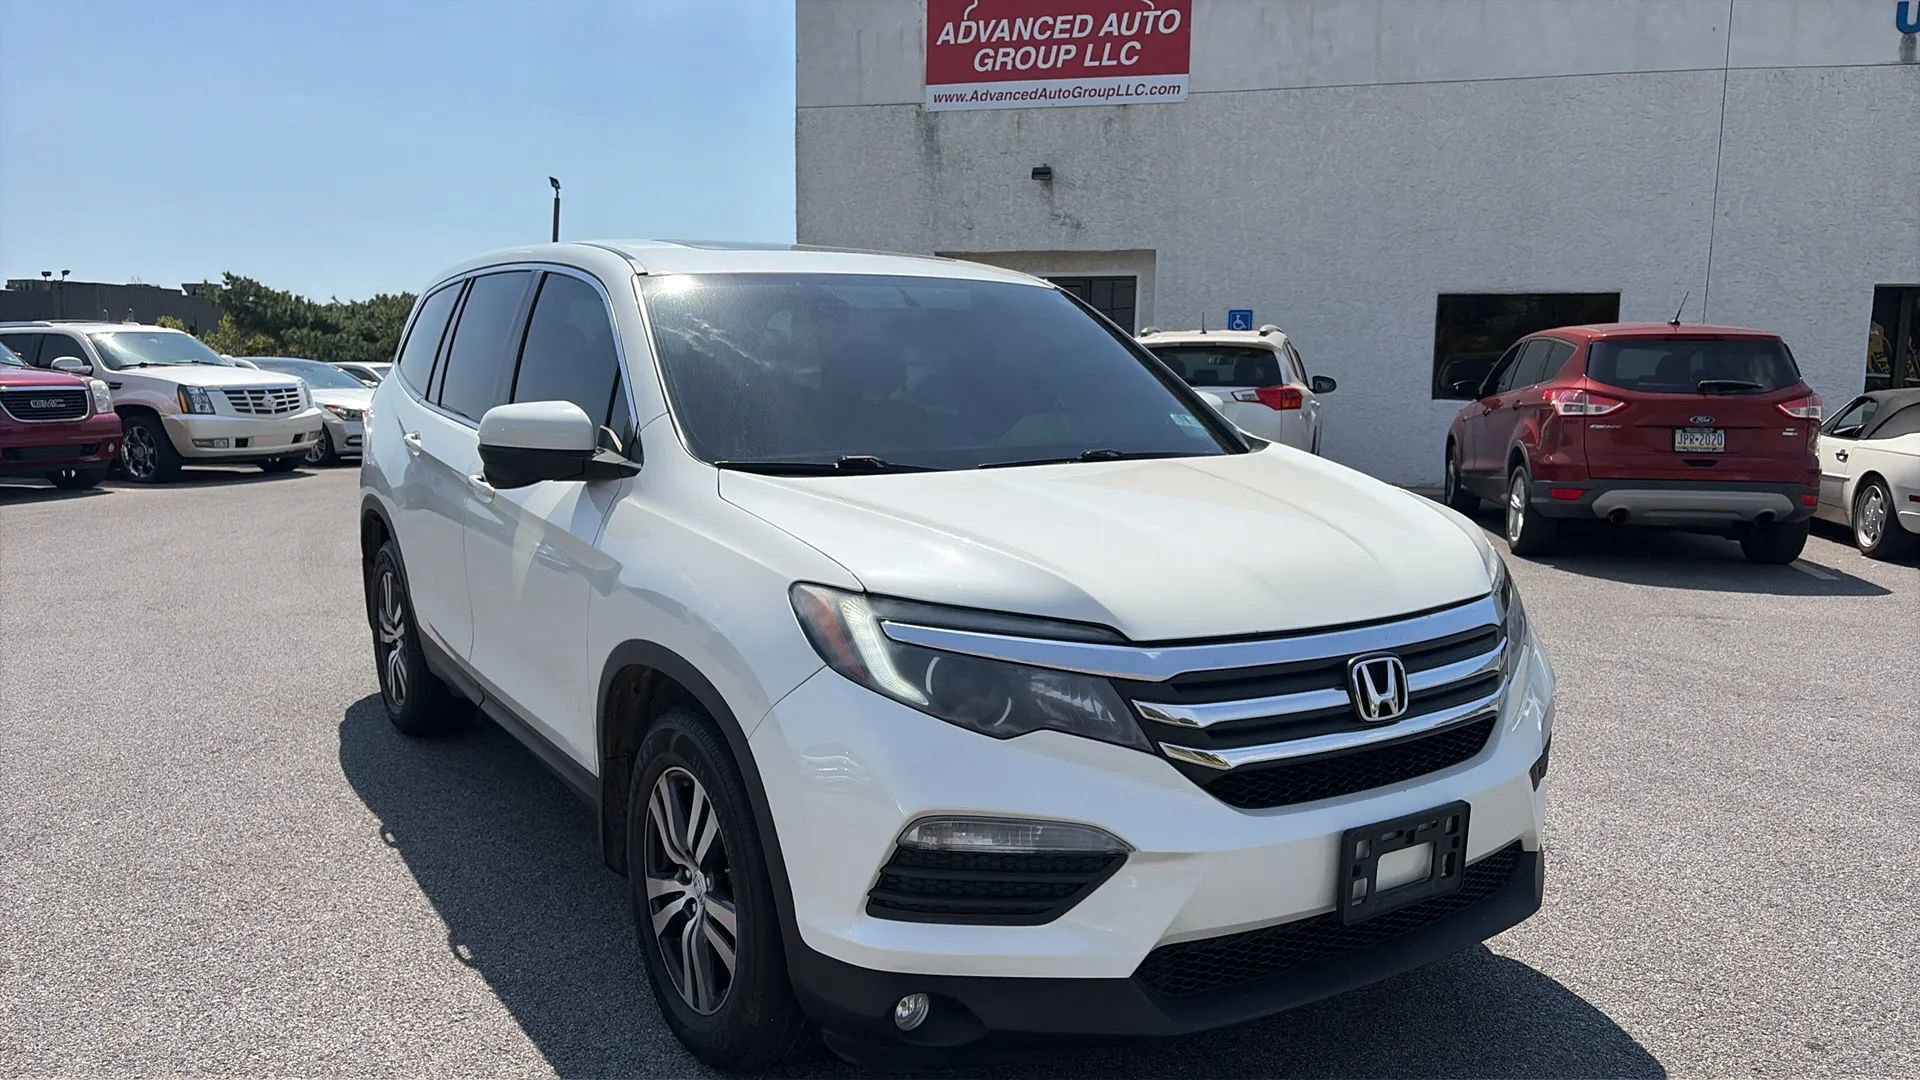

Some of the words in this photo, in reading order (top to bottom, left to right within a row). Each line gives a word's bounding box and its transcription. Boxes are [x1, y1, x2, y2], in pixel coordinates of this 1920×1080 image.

[936, 14, 1094, 46] ADVANCED
[1099, 9, 1182, 37] AUTO
[973, 45, 1076, 72] GROUP
[1083, 41, 1142, 67] LLC
[933, 83, 1181, 104] www.AdvancedAutoGroupLLC.com
[30, 399, 66, 408] GMC
